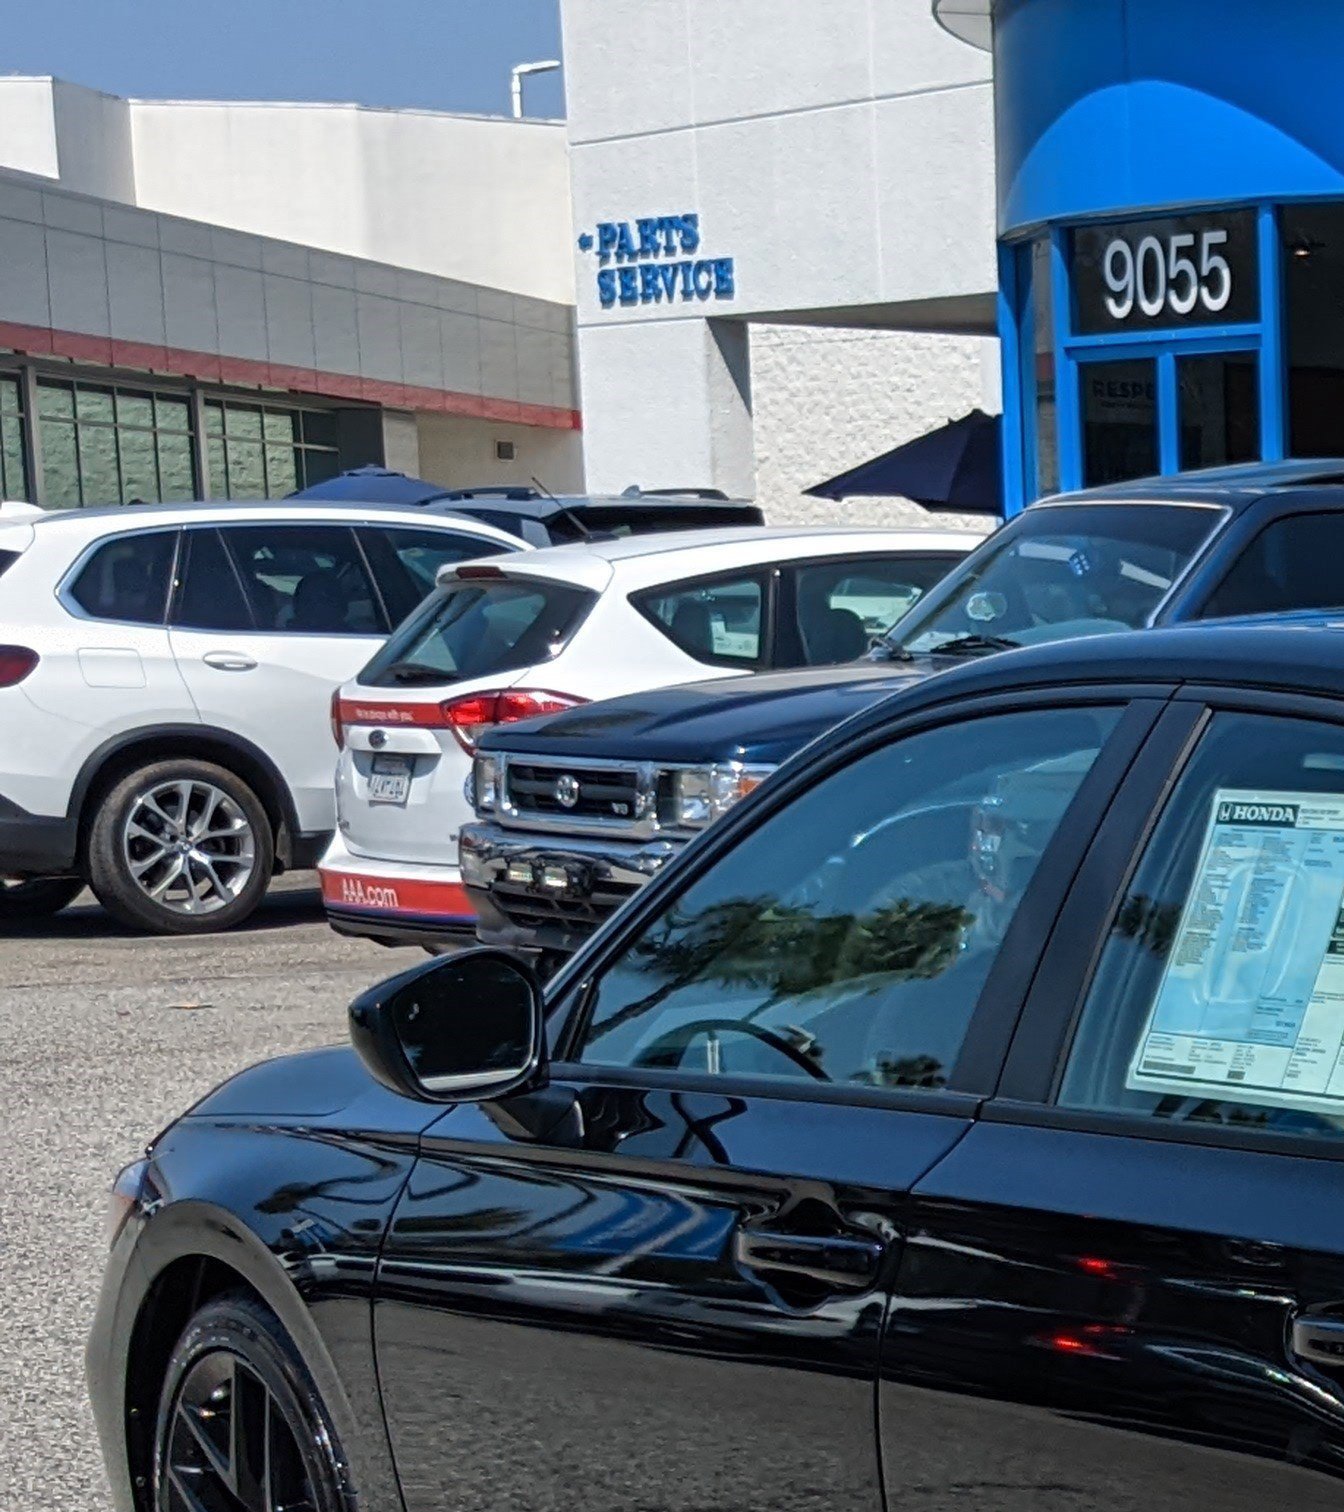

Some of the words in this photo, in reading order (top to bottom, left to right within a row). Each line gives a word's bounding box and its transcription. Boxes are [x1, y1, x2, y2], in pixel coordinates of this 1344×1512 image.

[596, 214, 700, 264] PARTS
[597, 258, 735, 309] SERVICE
[1104, 230, 1232, 319] 9055
[1233, 805, 1295, 823] HONDA
[342, 878, 399, 908] AAA.com
